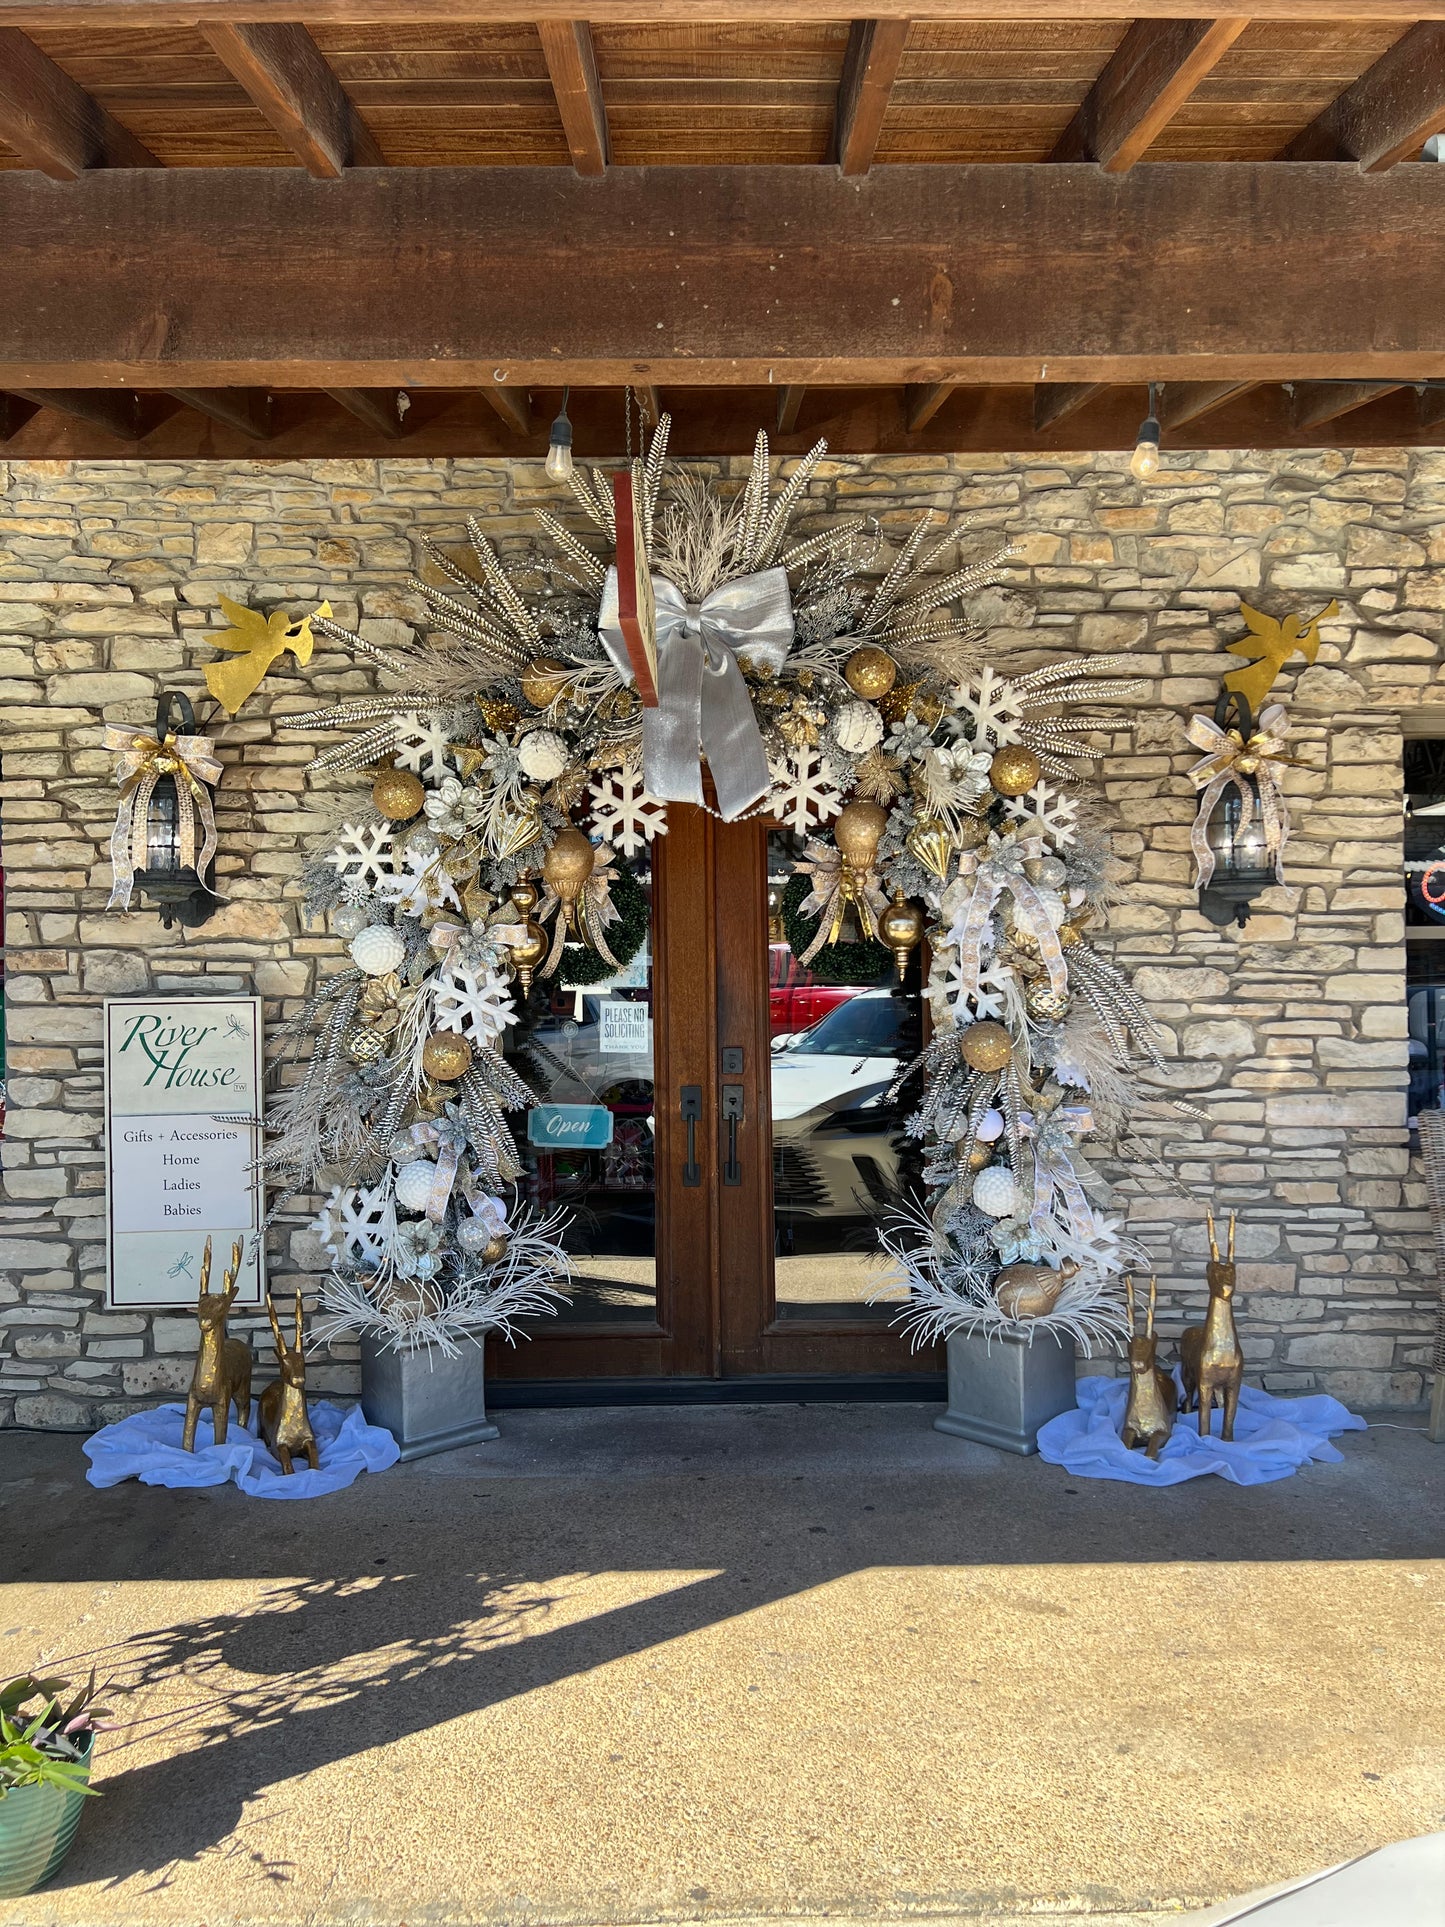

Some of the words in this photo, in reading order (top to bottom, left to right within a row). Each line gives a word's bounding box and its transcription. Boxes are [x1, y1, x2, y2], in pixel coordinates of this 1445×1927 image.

[604, 1007, 632, 1022] PLEASE
[633, 1007, 645, 1022] NO
[118, 1015, 217, 1053] River
[604, 1023, 645, 1038] SOLICITING
[143, 1046, 240, 1089] House
[546, 1114, 593, 1137] Open
[123, 1130, 153, 1142] Gifts
[170, 1129, 238, 1141] Accessories
[163, 1154, 200, 1165] Home
[163, 1178, 201, 1191] Ladies
[164, 1203, 202, 1216] Babies
